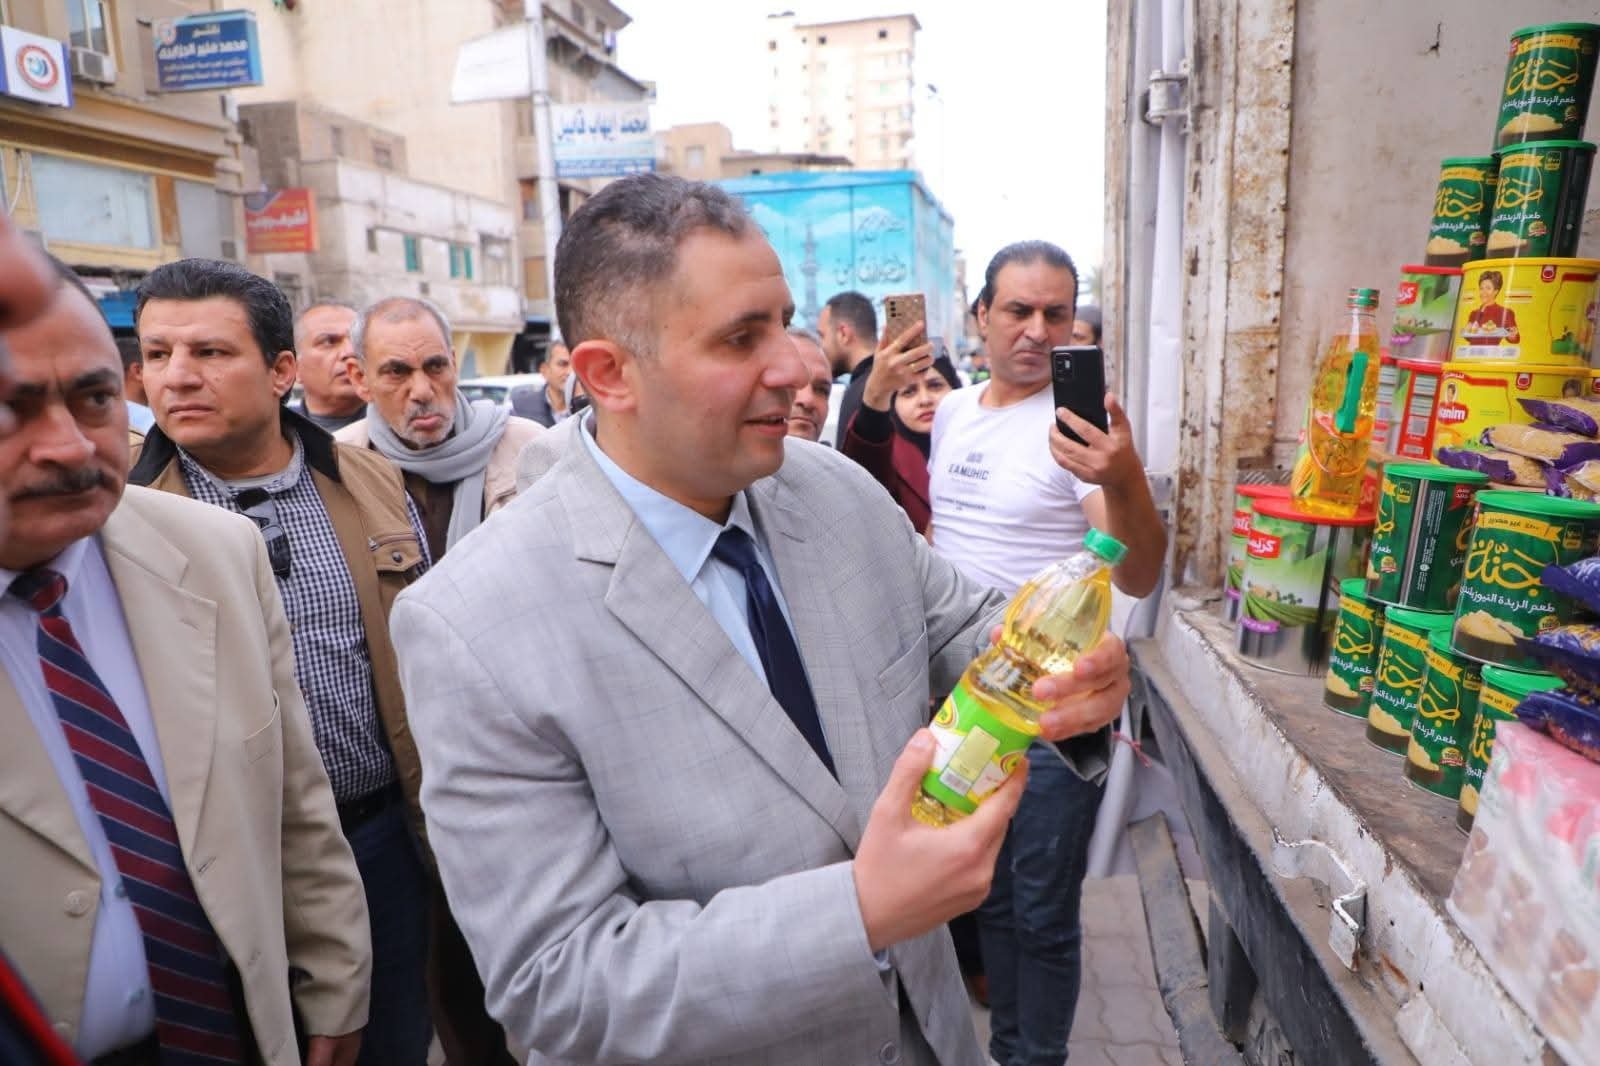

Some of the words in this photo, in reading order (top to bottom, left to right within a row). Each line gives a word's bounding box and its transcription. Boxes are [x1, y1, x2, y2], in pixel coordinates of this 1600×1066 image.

[1498, 595, 1529, 612] الزبدة
[1528, 603, 1556, 614] طعم
[1352, 666, 1373, 674] طعم
[1404, 702, 1417, 710] عم
[1416, 719, 1435, 738] الزبدة
[1434, 732, 1457, 745] طعم
